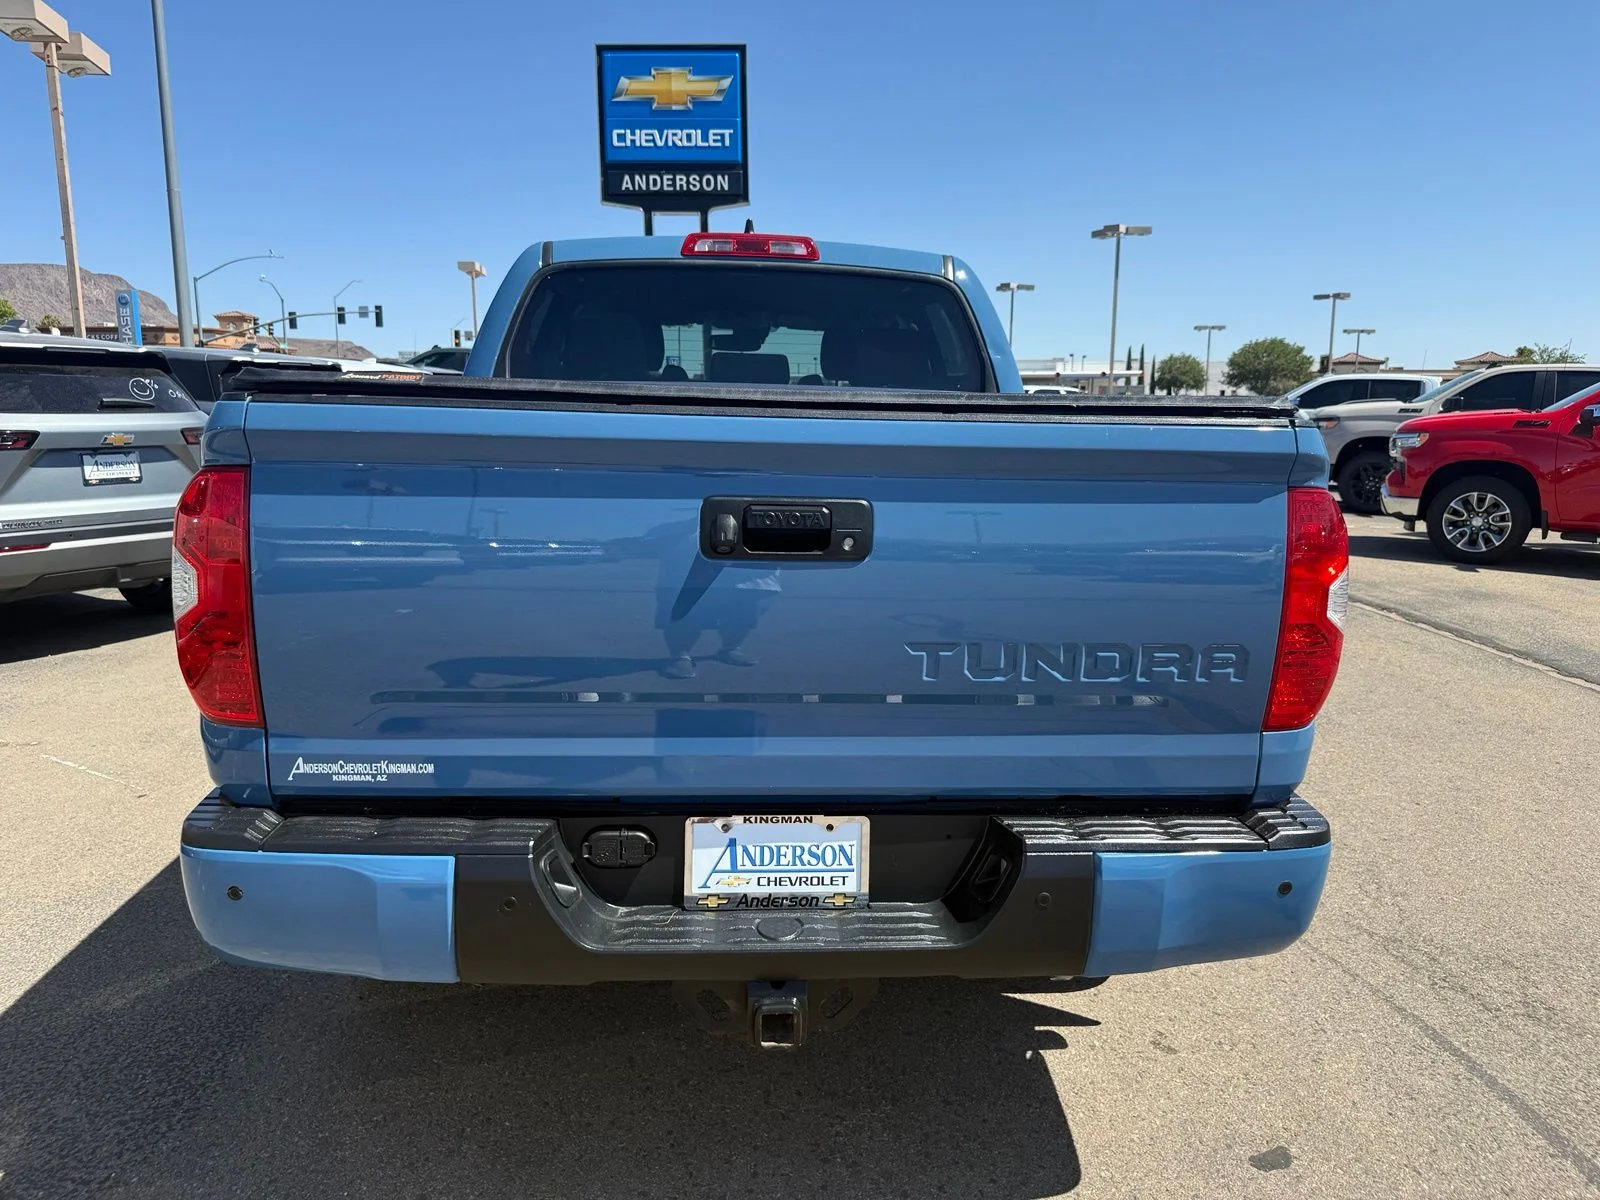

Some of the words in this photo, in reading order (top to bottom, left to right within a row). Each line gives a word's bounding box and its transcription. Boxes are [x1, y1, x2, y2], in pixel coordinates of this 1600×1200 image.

[611, 128, 734, 147] CHEVROLET
[621, 173, 729, 192] ANDERSON
[119, 307, 133, 345] HASE
[751, 511, 825, 528] TOYOTA
[903, 642, 1249, 683] TUNDRA
[332, 774, 375, 782] KINGMAN,
[376, 774, 388, 782] AZ
[743, 815, 814, 824] KINGMAN
[698, 837, 855, 889] ANDERSON
[756, 875, 849, 887] CHEVROLET
[736, 893, 820, 909] Anderson
